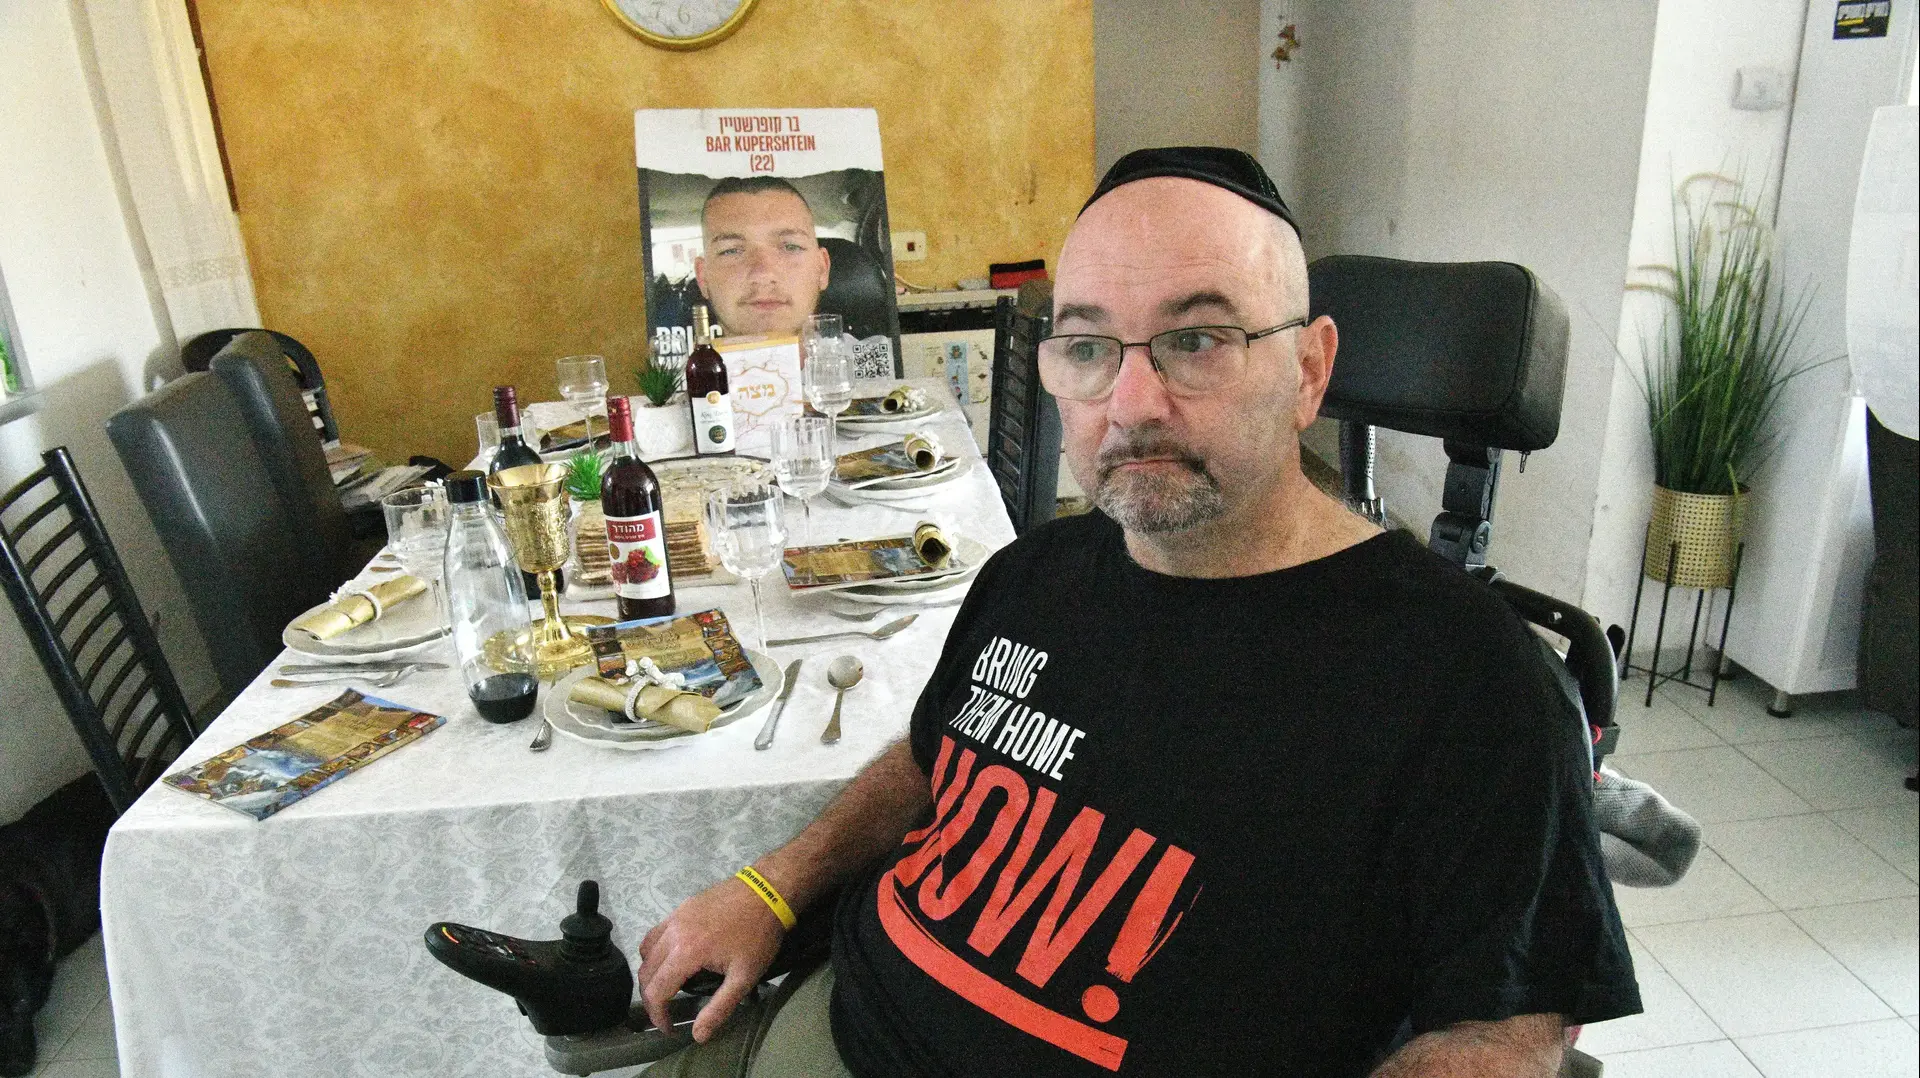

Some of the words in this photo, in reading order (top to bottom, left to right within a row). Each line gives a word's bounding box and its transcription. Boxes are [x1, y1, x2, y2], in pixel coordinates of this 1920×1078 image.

[677, 4, 691, 25] 6
[719, 116, 782, 134] קופרשטיין
[785, 116, 800, 132] בר
[706, 136, 732, 152] BAR
[734, 135, 816, 152] KUPERSHTEIN
[750, 154, 775, 173] (22)
[656, 325, 723, 356] BRI
[737, 383, 777, 400] מצה
[611, 523, 645, 534] מהודר
[971, 635, 1049, 699] BRING
[948, 684, 1014, 744] THEM
[992, 703, 1087, 781] HOME
[893, 734, 1202, 1023] NOW!
